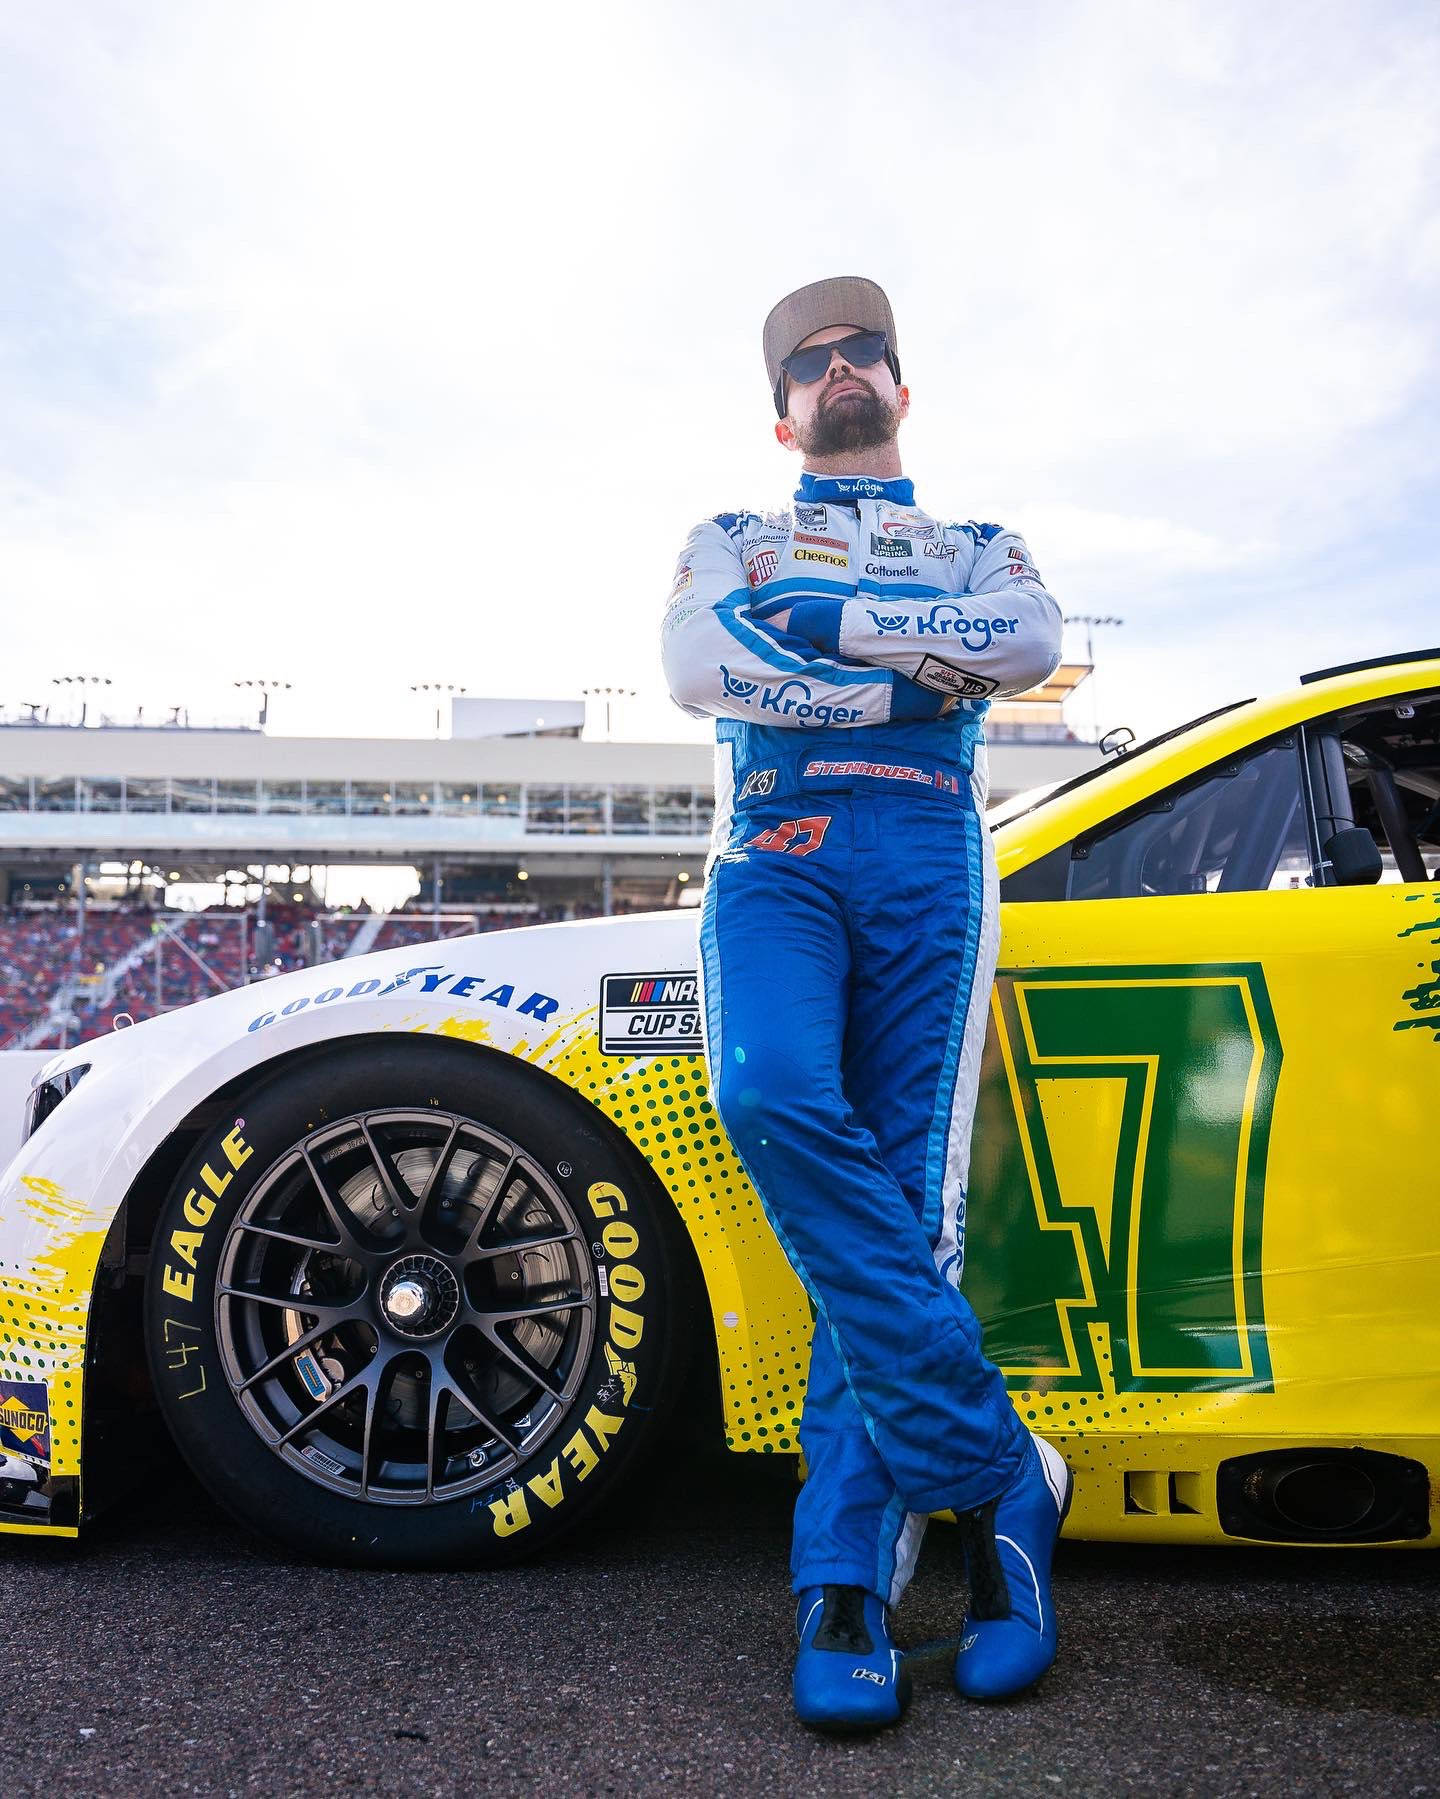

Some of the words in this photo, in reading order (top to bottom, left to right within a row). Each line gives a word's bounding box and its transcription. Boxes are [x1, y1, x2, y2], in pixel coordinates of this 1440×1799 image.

[852, 478, 884, 497] Kroger
[794, 548, 848, 568] Cheerios
[874, 550, 908, 558] SPRING
[877, 544, 903, 552] IRISH
[865, 563, 920, 577] Cottonelle
[916, 605, 1020, 652] Kroger
[760, 680, 864, 729] Kroger
[803, 760, 922, 782] STENHOUSE
[744, 815, 832, 857] 47
[628, 1013, 677, 1035] CUP
[163, 1126, 254, 1302] EAGLE
